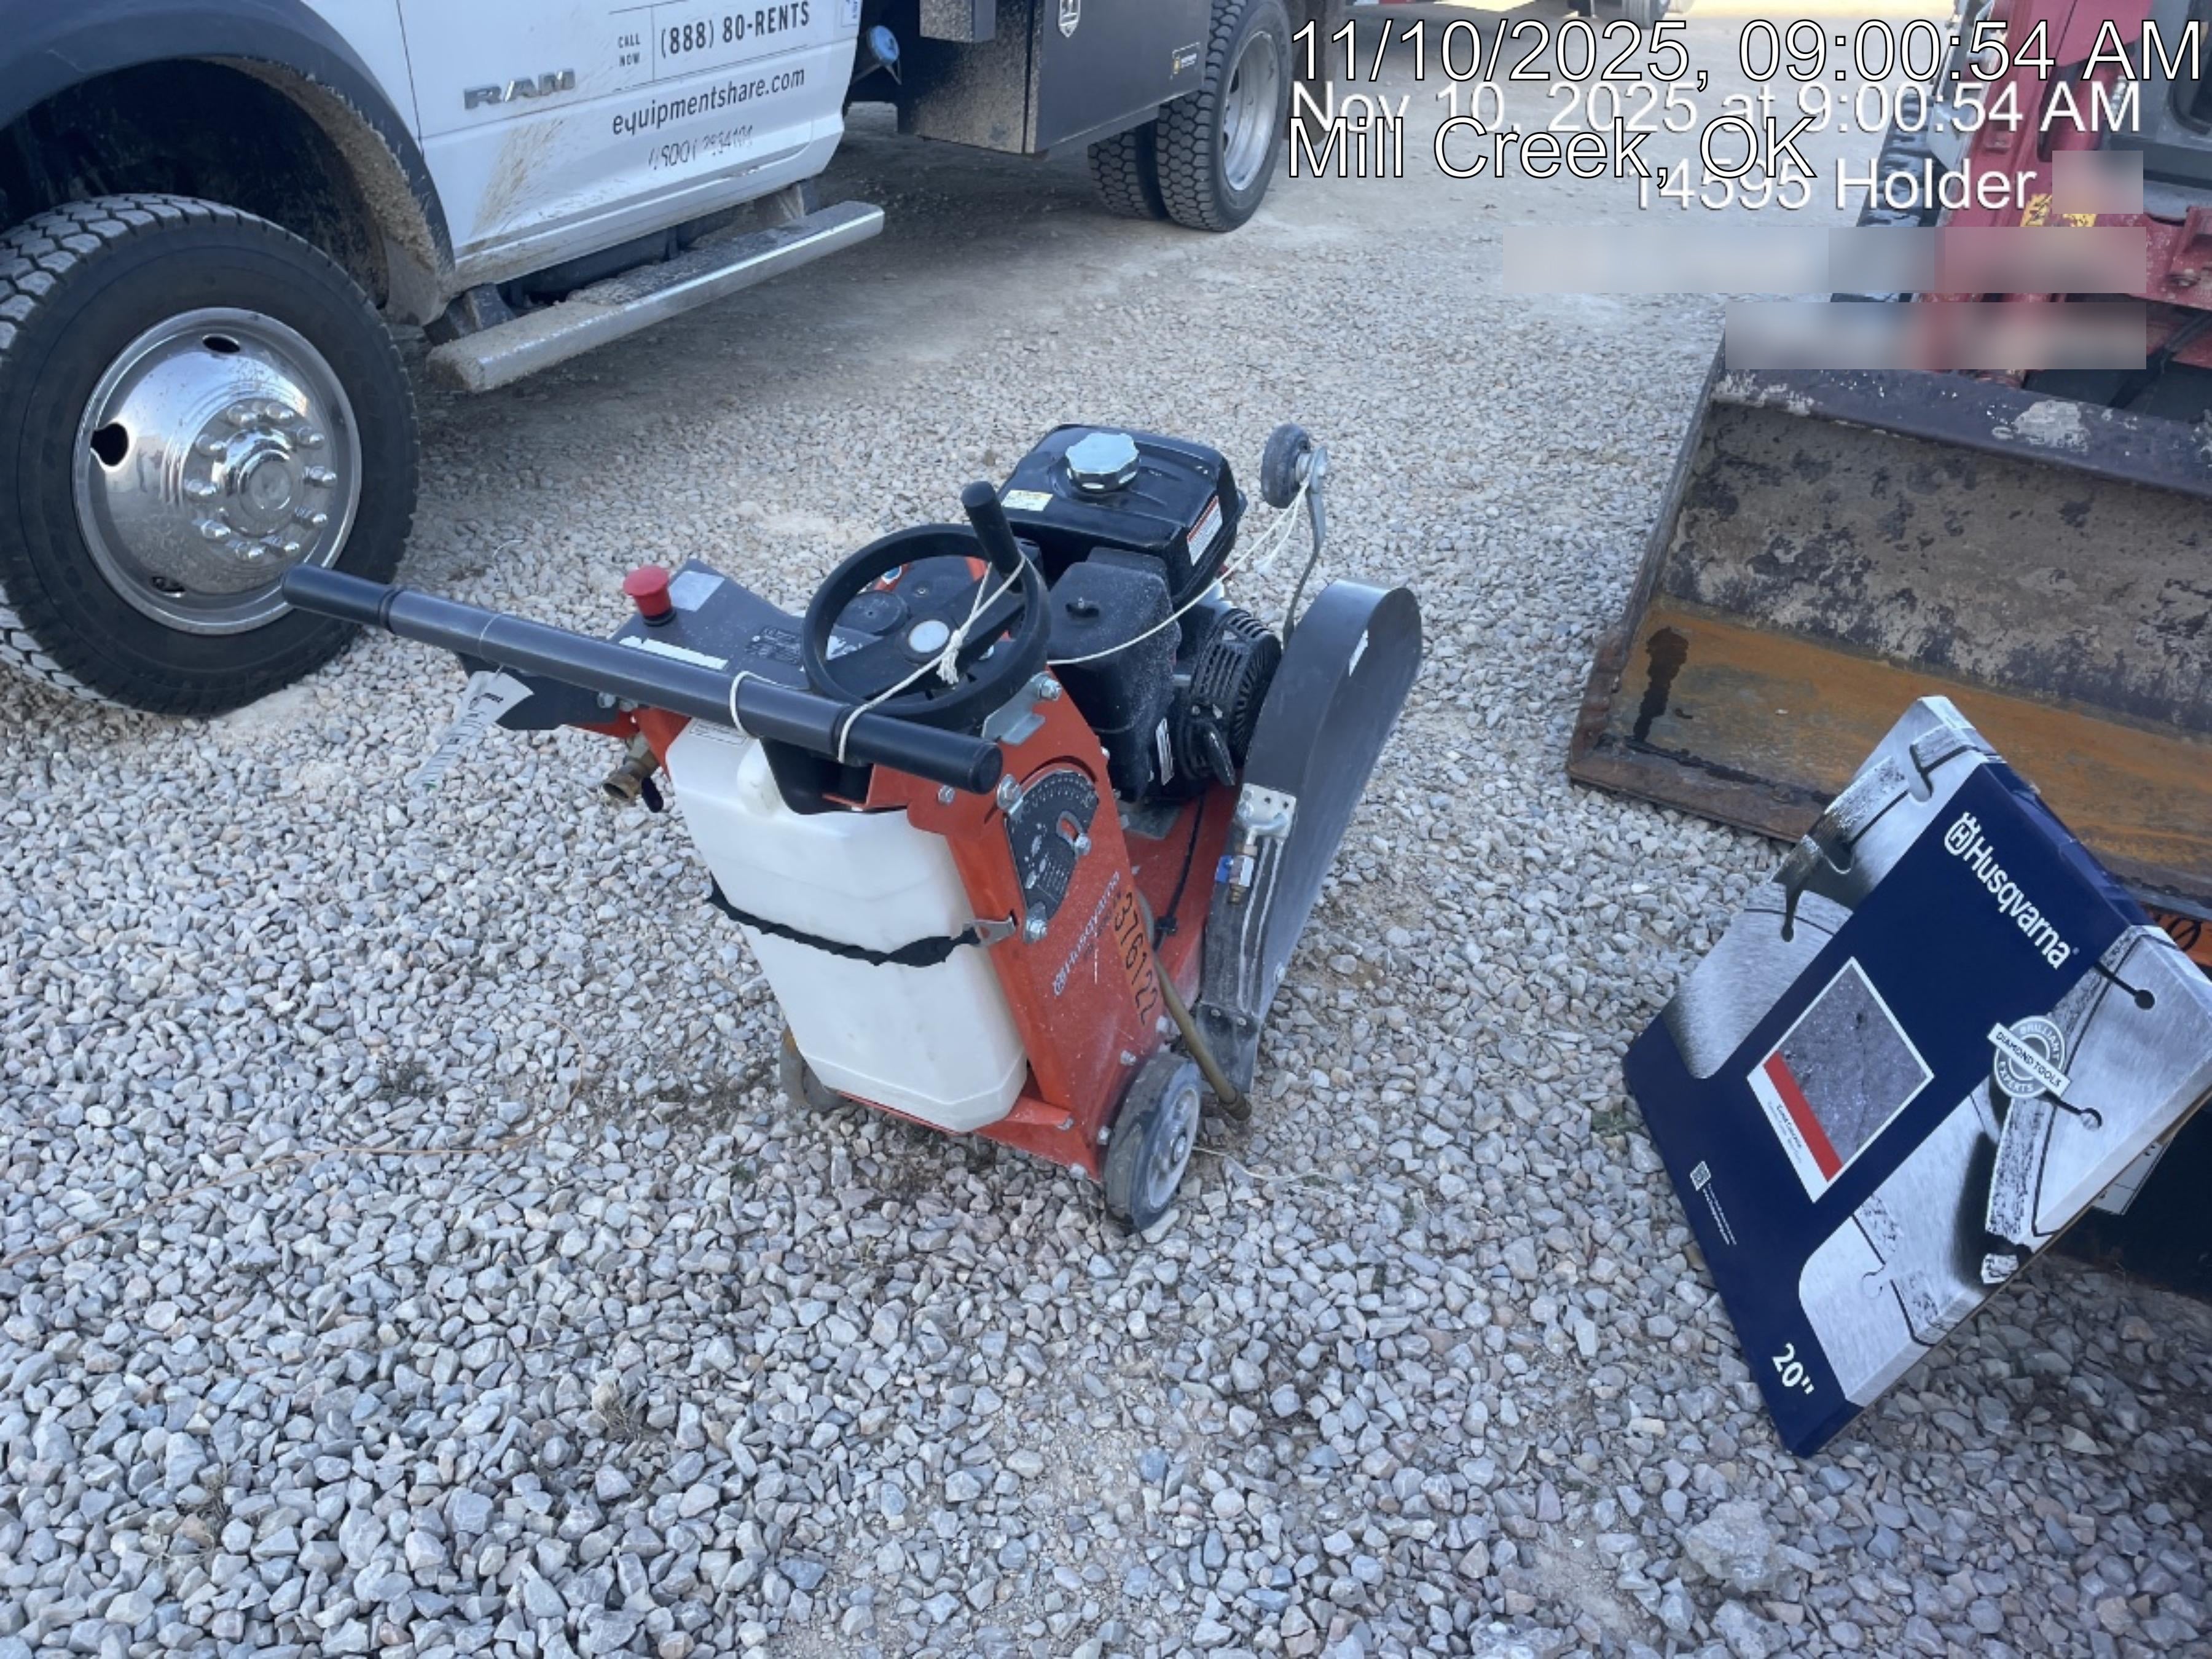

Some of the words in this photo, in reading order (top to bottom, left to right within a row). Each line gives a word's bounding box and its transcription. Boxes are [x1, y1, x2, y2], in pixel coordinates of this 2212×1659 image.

[618, 33, 640, 49] CALL
[661, 20, 714, 59] (888)
[723, 1, 810, 42] 80-RENTS
[619, 53, 640, 66] NOW
[464, 69, 575, 109] RAM
[613, 68, 805, 135] equipmentshare.com
[1963, 836, 2071, 970] Husqvarna
[1996, 1032, 2034, 1065] DIAMOND
[2033, 1061, 2062, 1088] TOOLS
[2019, 1023, 2061, 1061] BRILLIANT
[1999, 1061, 2034, 1092] EXPERTS
[1772, 1342, 1814, 1395] 20"
